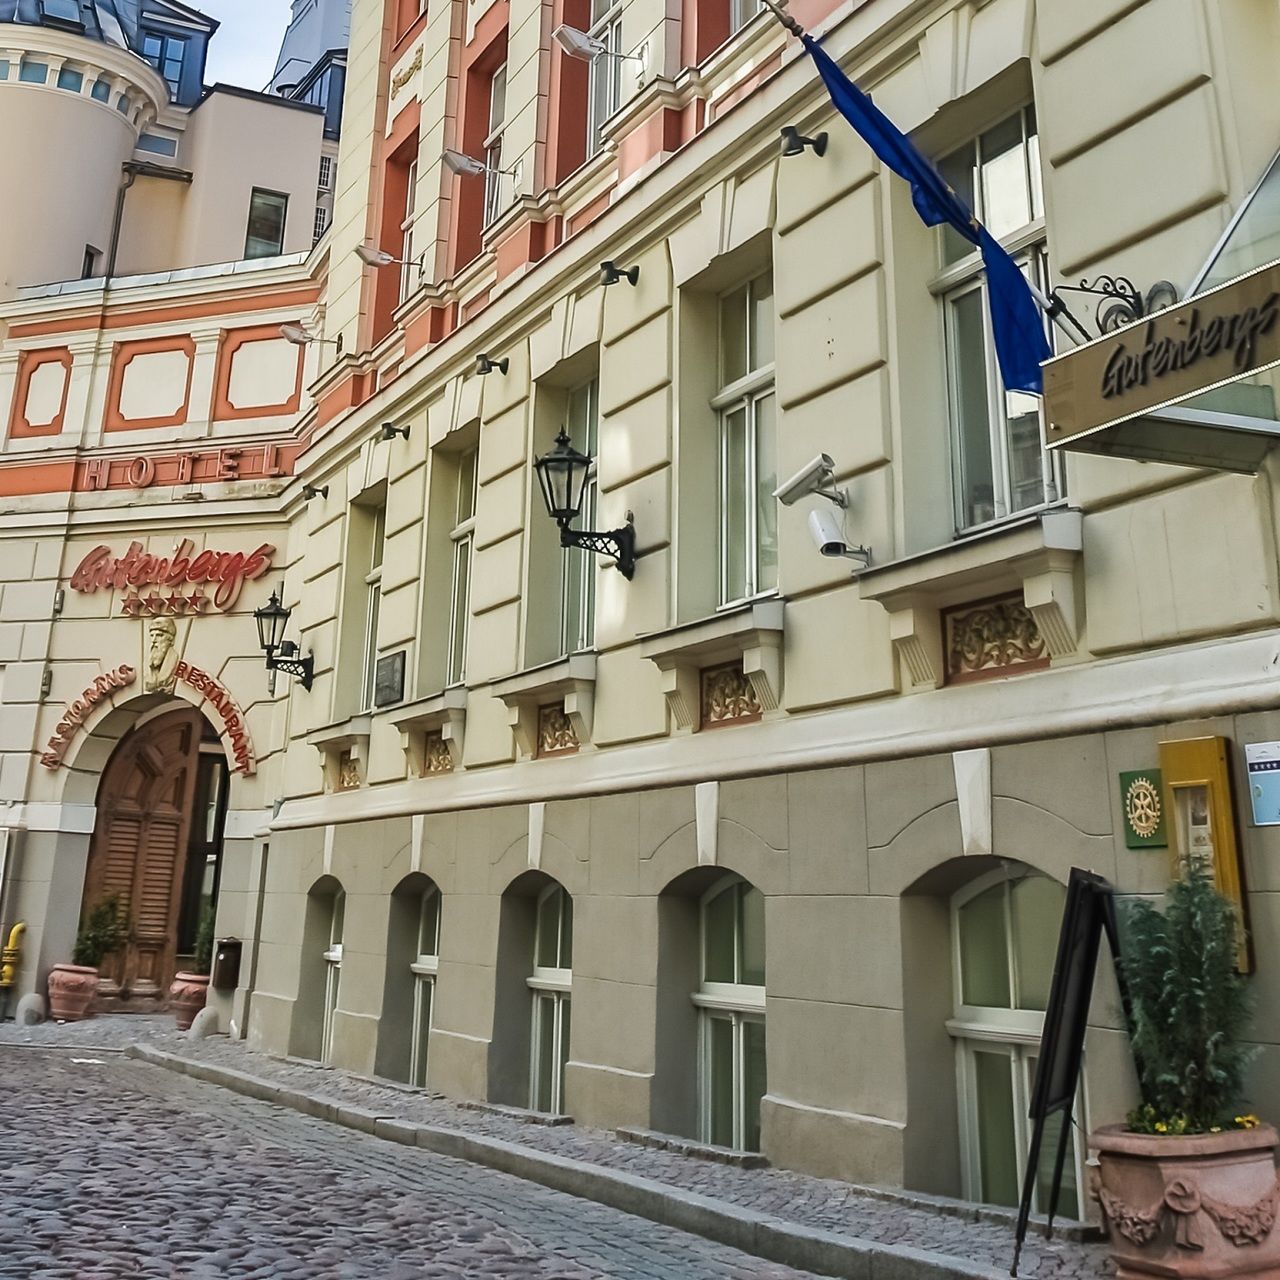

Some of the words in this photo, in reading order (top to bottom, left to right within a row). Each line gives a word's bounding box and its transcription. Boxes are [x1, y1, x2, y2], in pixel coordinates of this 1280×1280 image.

[82, 443, 286, 491] HOTEL
[70, 538, 277, 613] Gutenbergs
[174, 659, 257, 778] RESTAURANT
